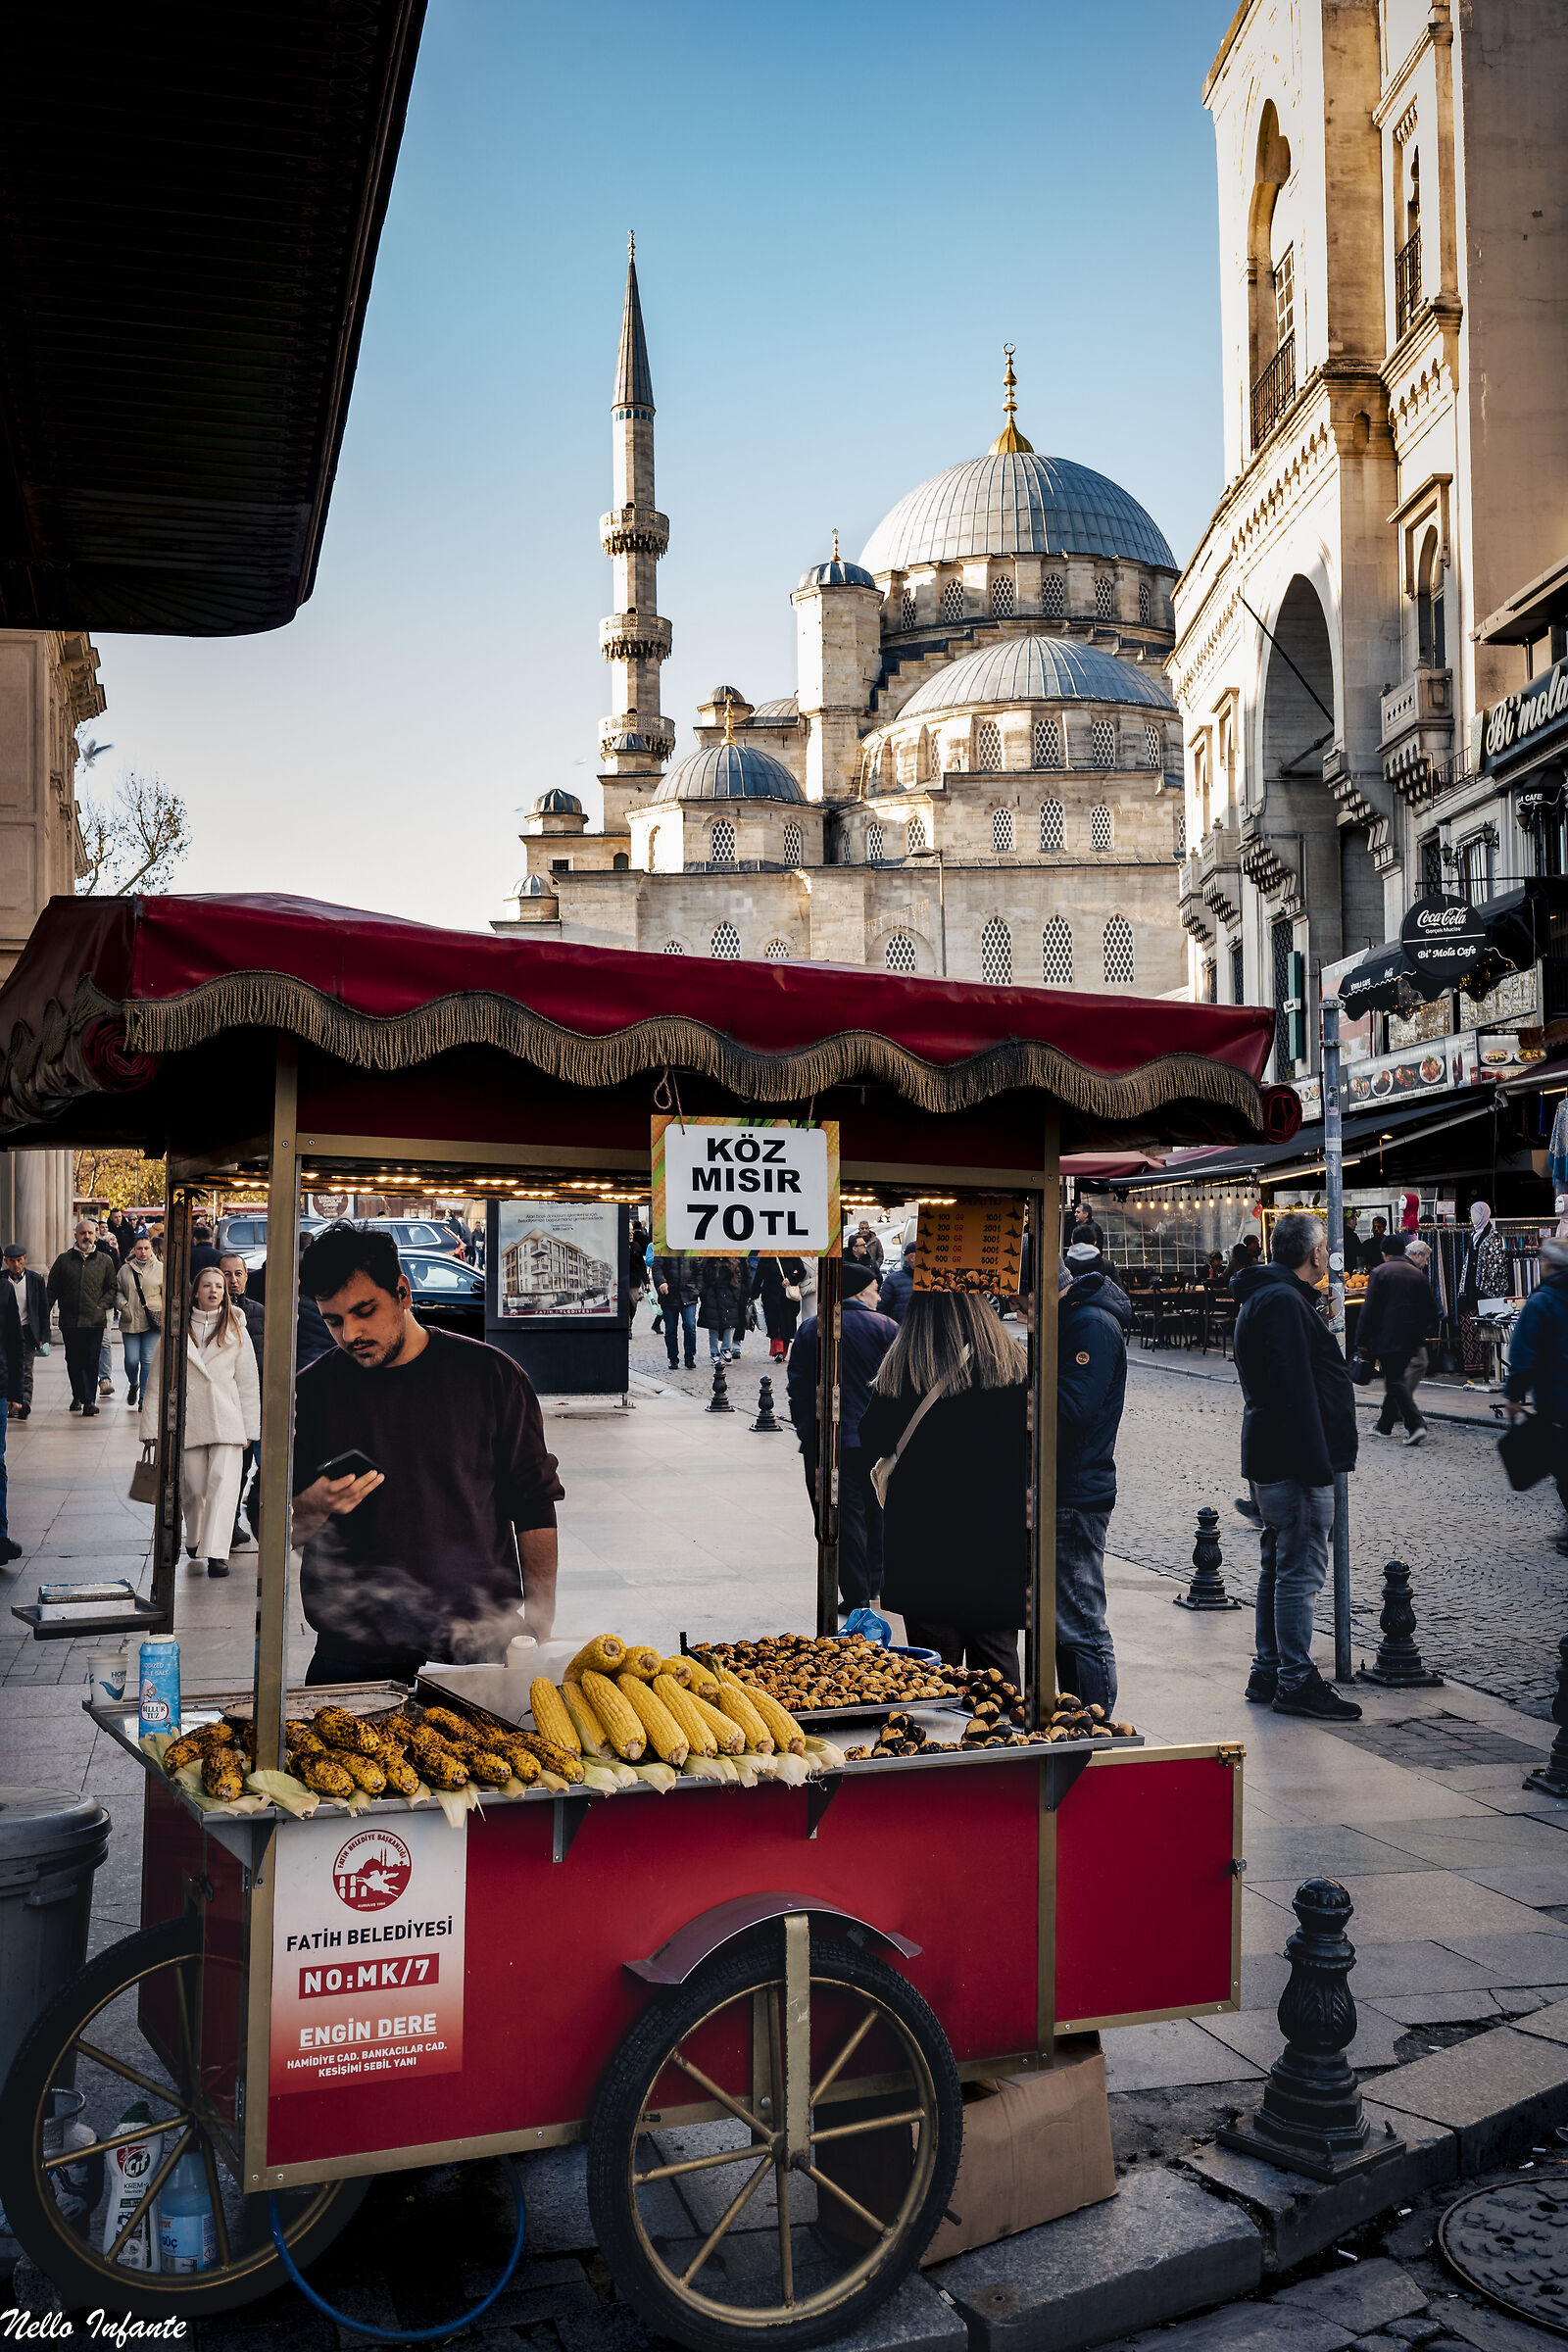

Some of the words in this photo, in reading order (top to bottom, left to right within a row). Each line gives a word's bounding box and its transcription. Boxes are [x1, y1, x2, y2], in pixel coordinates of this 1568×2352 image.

[1433, 947, 1456, 958] Mola
[1456, 945, 1477, 957] Cafe
[707, 1133, 786, 1164] KÖZ
[692, 1167, 803, 1194] MISIR
[286, 1928, 342, 1952] FATİH
[347, 1915, 453, 1945] BELEDİYESİ
[304, 1958, 430, 1994] NO:MK/7
[299, 2018, 371, 2048] ENGİN
[377, 2013, 437, 2036] DERE
[287, 2053, 335, 2070] HAMİDİYE
[336, 2051, 360, 2064] CAD.
[362, 2044, 423, 2061] BANKACILAR
[424, 2041, 447, 2054] CAD.
[318, 2063, 362, 2078] KESİŞİMİ
[363, 2059, 392, 2072] SEBİL
[393, 2056, 416, 2068] YANI
